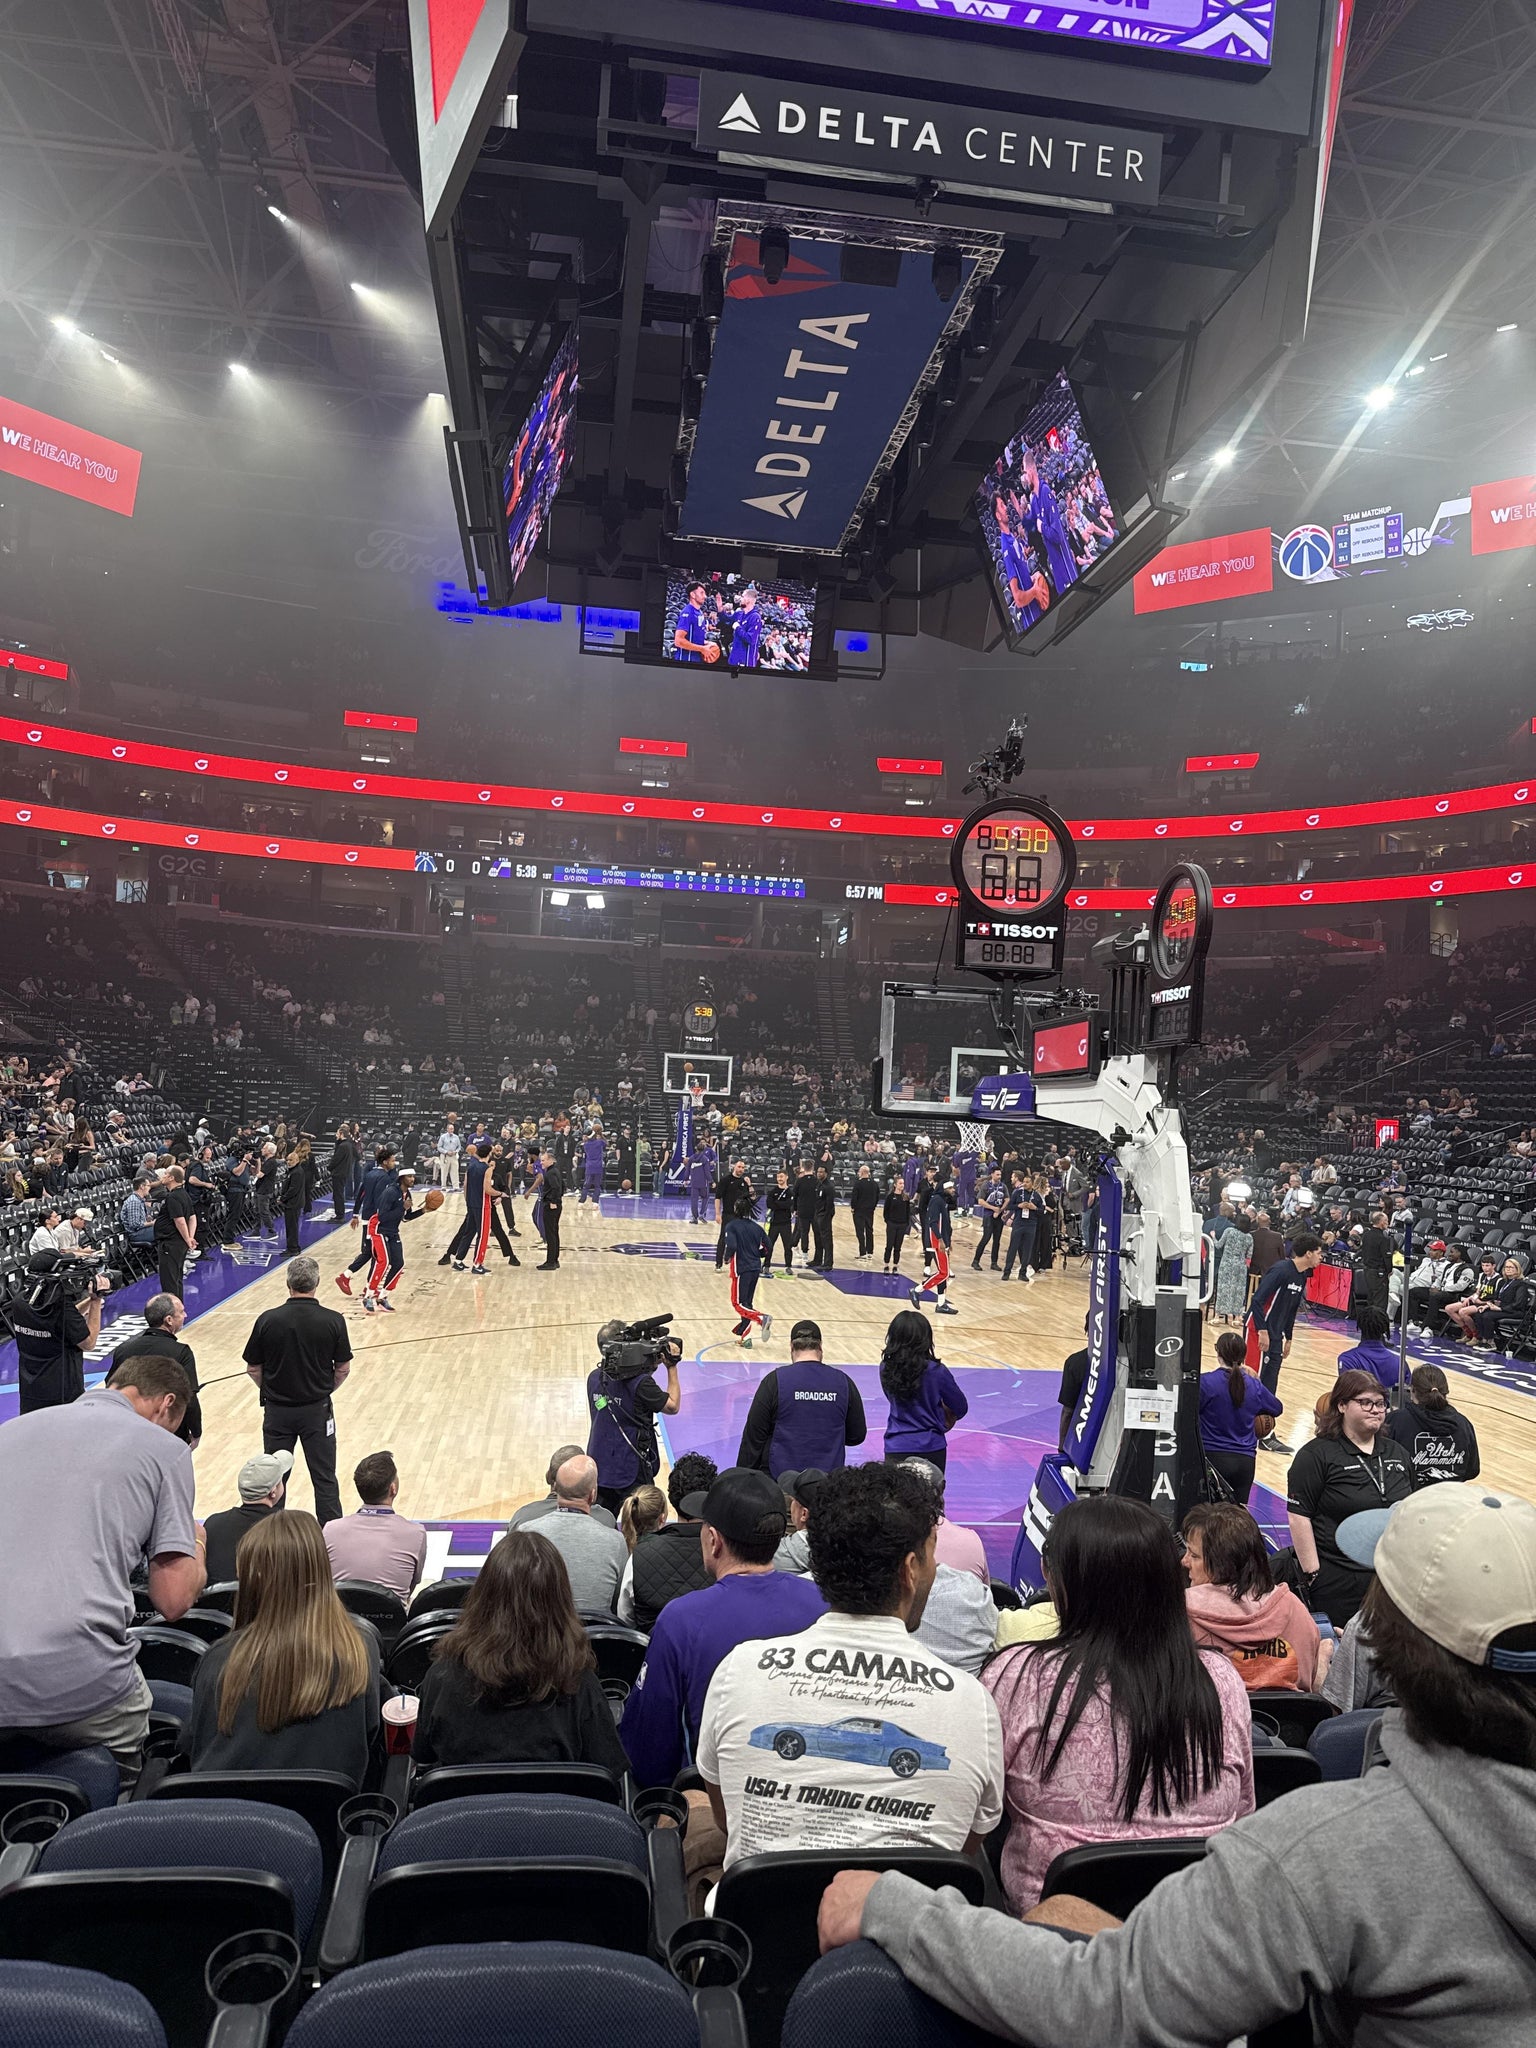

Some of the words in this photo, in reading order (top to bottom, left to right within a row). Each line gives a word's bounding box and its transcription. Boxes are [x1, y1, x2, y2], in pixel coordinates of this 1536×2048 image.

[777, 100, 942, 155] DELTA
[965, 127, 1144, 182] CENTER
[755, 312, 870, 478] DELTA
[2, 426, 31, 451] WE
[33, 439, 81, 470] HEAR
[84, 458, 118, 483] YOU
[1343, 512, 1360, 522] TEAM
[1361, 505, 1392, 518] MATCHUP
[1491, 504, 1523, 524] WE
[1151, 570, 1176, 587] WE
[1178, 562, 1220, 582] HEAR
[1222, 556, 1255, 573] YOU
[158, 854, 206, 875] G2G
[446, 859, 455, 873] 0
[472, 861, 481, 874] 0
[516, 863, 537, 878] 5:38
[845, 884, 866, 899] 6:57
[867, 886, 883, 900] PM
[991, 922, 1058, 940] TISSOT
[1161, 985, 1191, 1002] TISSOT
[694, 1007, 713, 1017] 5:38
[1074, 1310, 1104, 1443] AMERICA
[1096, 1217, 1109, 1308] FIRST
[794, 1391, 837, 1402] BROADCAST
[1410, 1450, 1466, 1465] Mammoth
[1425, 1442, 1456, 1457] Utah
[757, 1647, 796, 1671] 83
[804, 1647, 955, 1693] CAMARO
[767, 1667, 814, 1681] Command
[815, 1672, 869, 1687] performance
[873, 1679, 884, 1695] by
[889, 1678, 938, 1696] Chevrolet
[789, 1680, 810, 1697] The
[811, 1685, 862, 1701] Heartbeat
[861, 1692, 873, 1706] of
[874, 1692, 916, 1710] America
[743, 1775, 792, 1801] USA-1
[795, 1785, 865, 1810] TAKING
[864, 1793, 936, 1822] CHARGE
